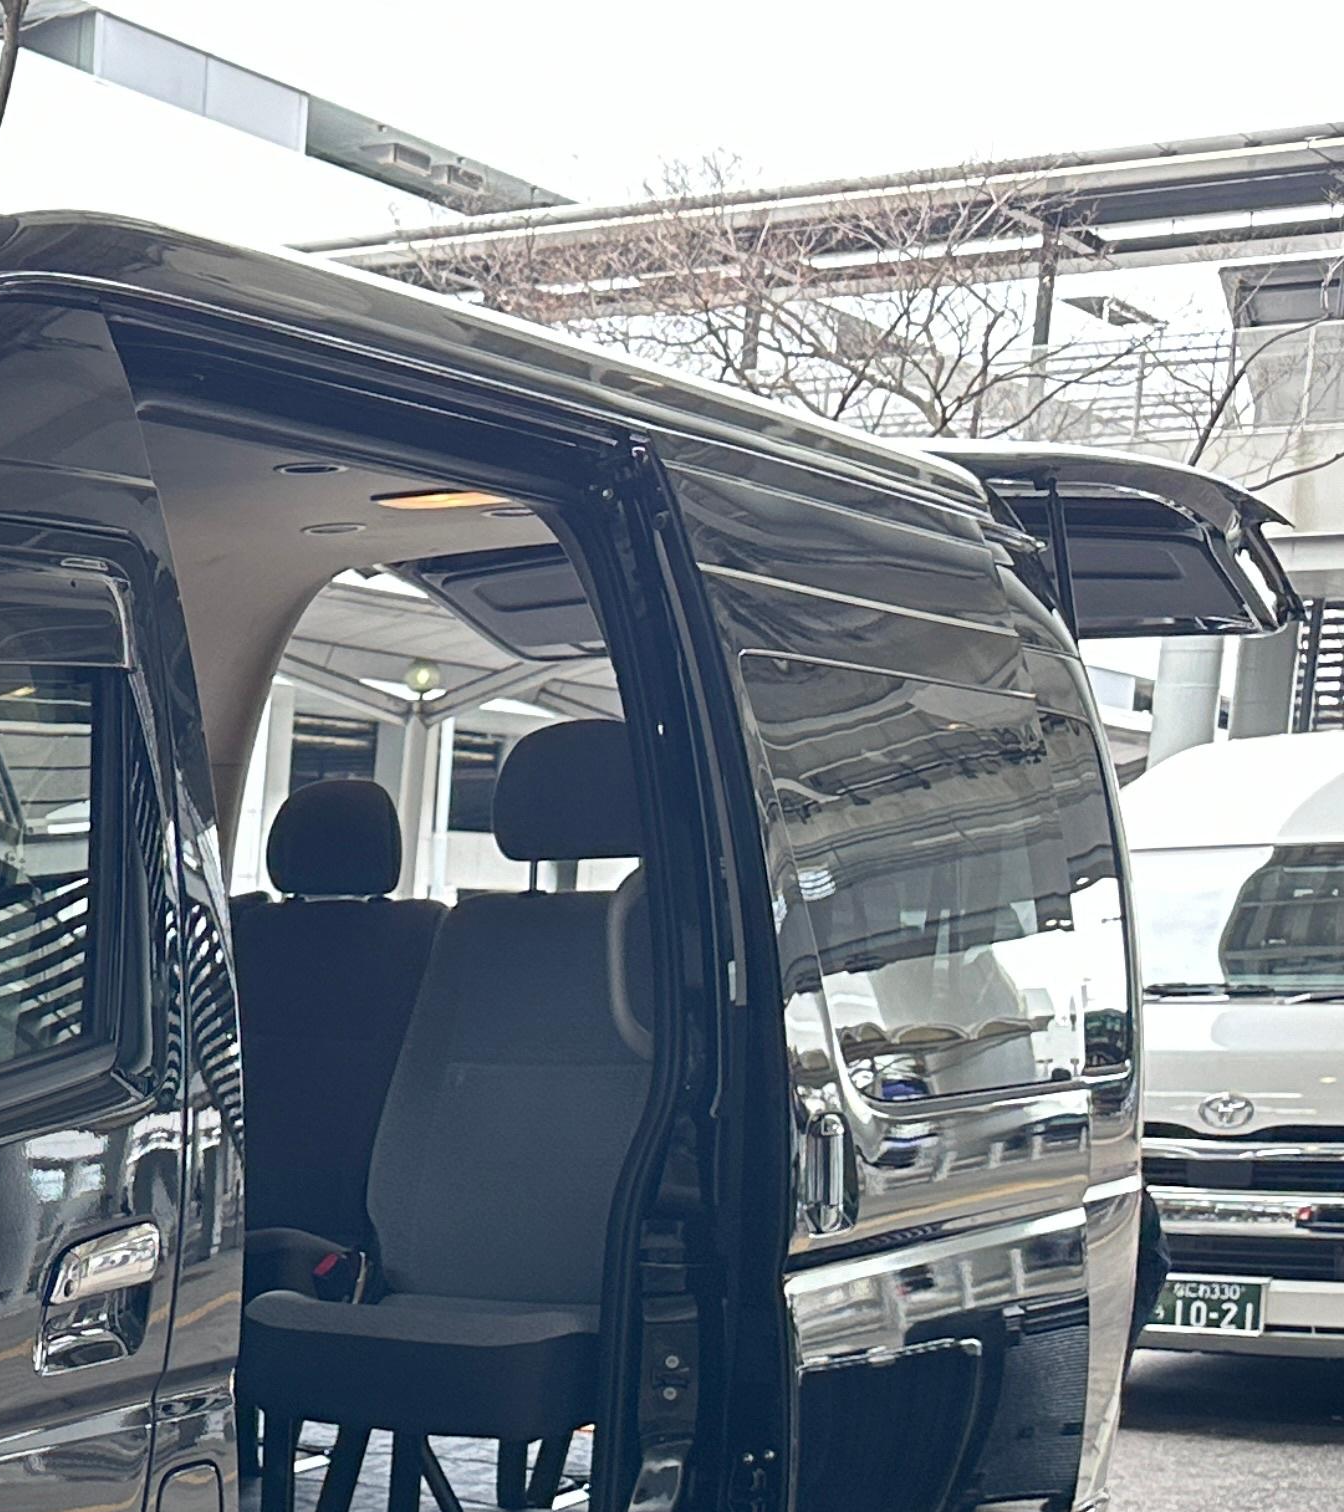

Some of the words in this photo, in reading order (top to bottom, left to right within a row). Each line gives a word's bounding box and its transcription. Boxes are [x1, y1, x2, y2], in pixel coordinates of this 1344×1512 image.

[1173, 1282, 1241, 1300] なにわ330
[1175, 1299, 1253, 1330] 10-21
